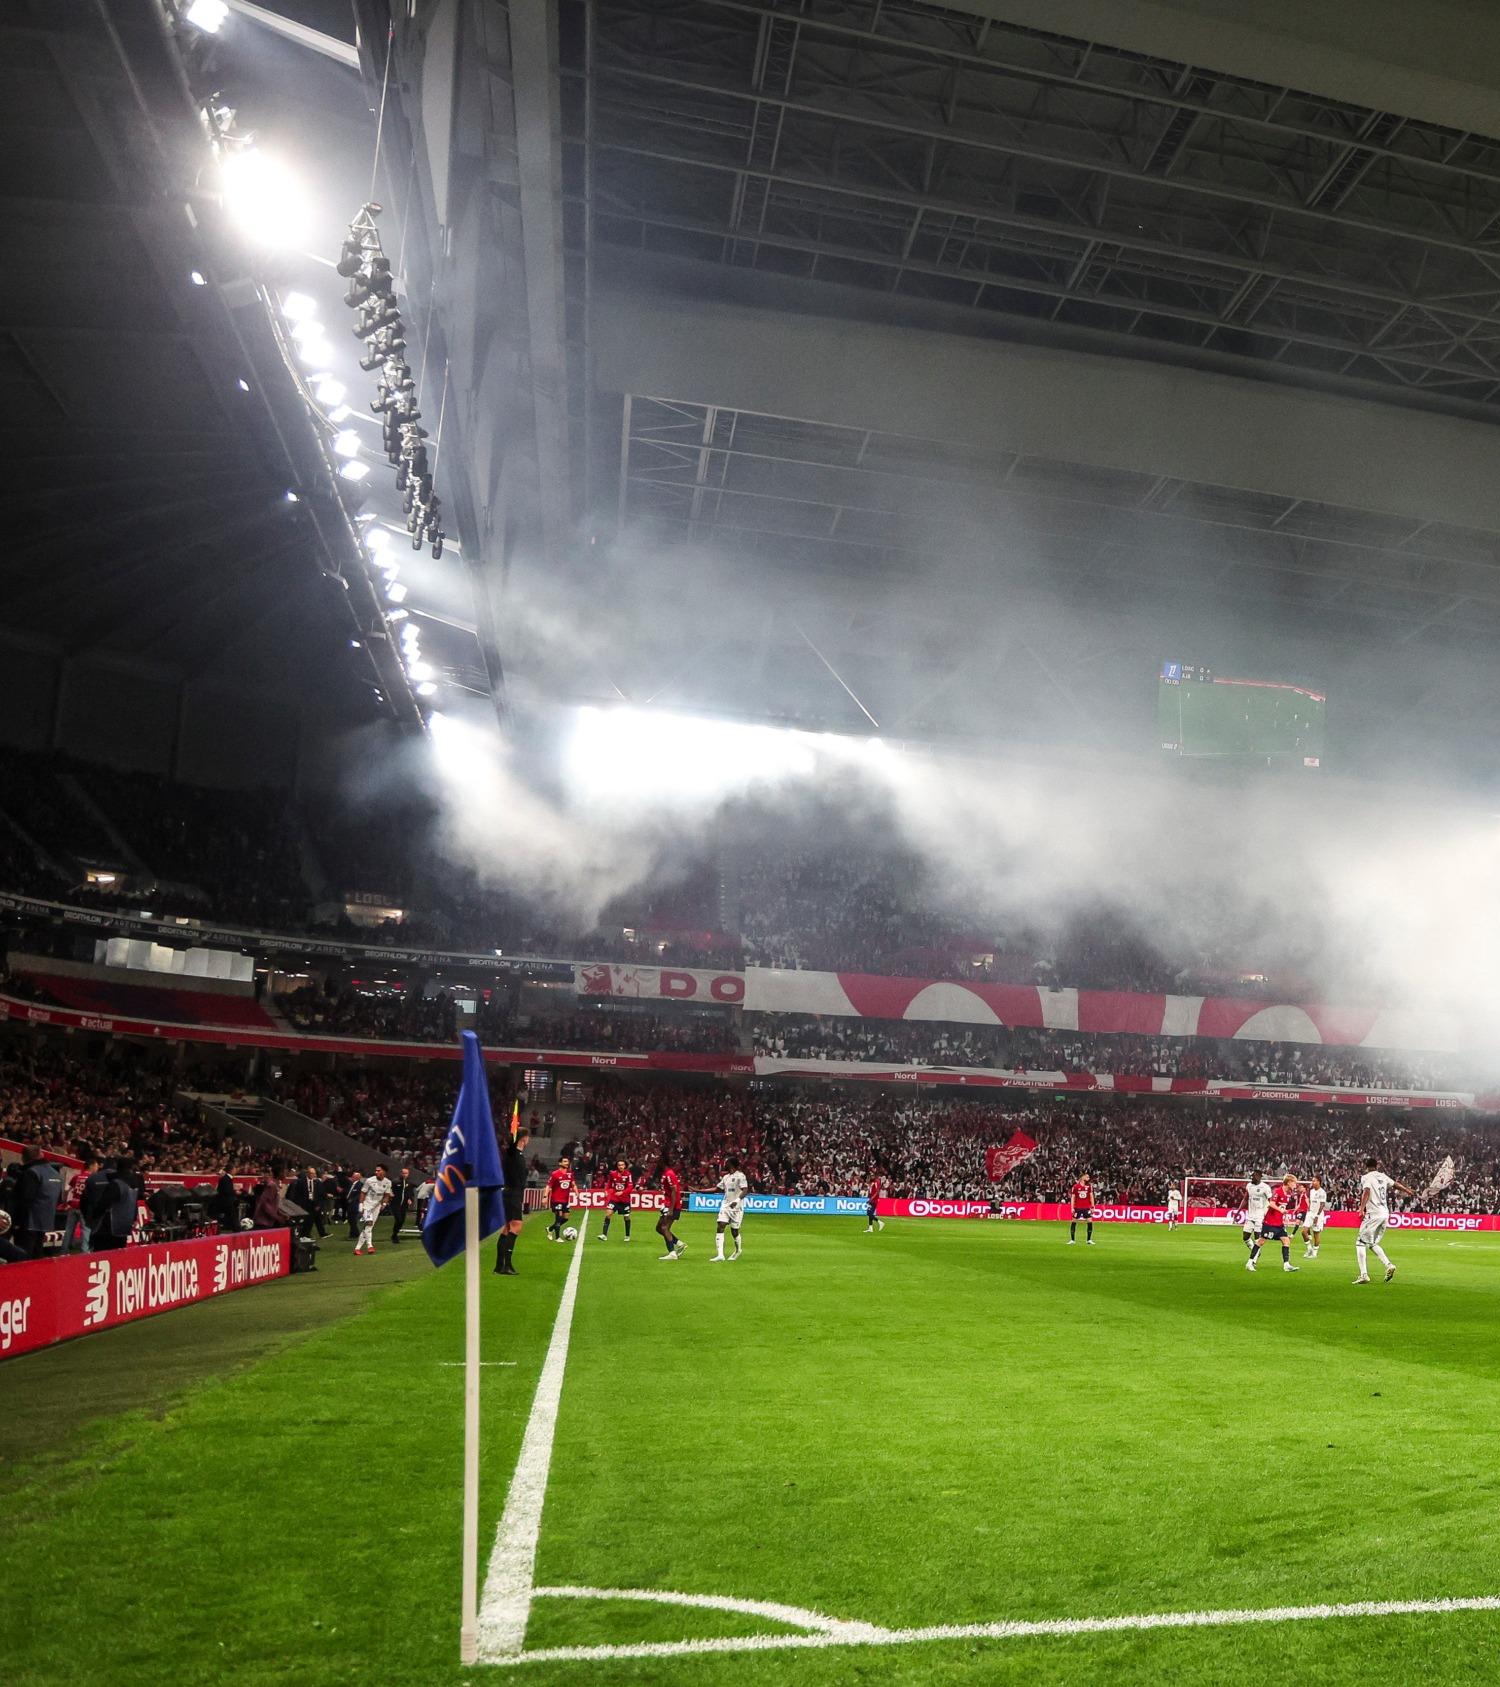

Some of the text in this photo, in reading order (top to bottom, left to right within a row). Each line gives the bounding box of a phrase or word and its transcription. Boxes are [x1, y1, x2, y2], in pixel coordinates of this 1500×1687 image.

[63, 911, 102, 924] DECATHLON
[158, 925, 242, 944] DECATHLON ARENA
[260, 938, 347, 955] DECATHLON ARENA
[365, 949, 452, 964] DECATHLON ARENA
[469, 957, 554, 971] DECATHLON ARENA
[88, 1019, 113, 1031] actual
[591, 1056, 617, 1065] Nord
[894, 1072, 917, 1080] Nord
[1261, 1091, 1300, 1099] DECATHLON
[1366, 1096, 1388, 1105] LOSC
[1436, 1099, 1457, 1108] LOSC
[569, 1191, 605, 1207] OSC
[630, 1193, 665, 1209] OSC
[695, 1196, 723, 1208] Nor
[743, 1197, 778, 1209] Nord
[790, 1198, 824, 1210] Nord
[1402, 1214, 1483, 1231] boulanger
[231, 1236, 281, 1284] new balance
[116, 1251, 199, 1316] new balance
